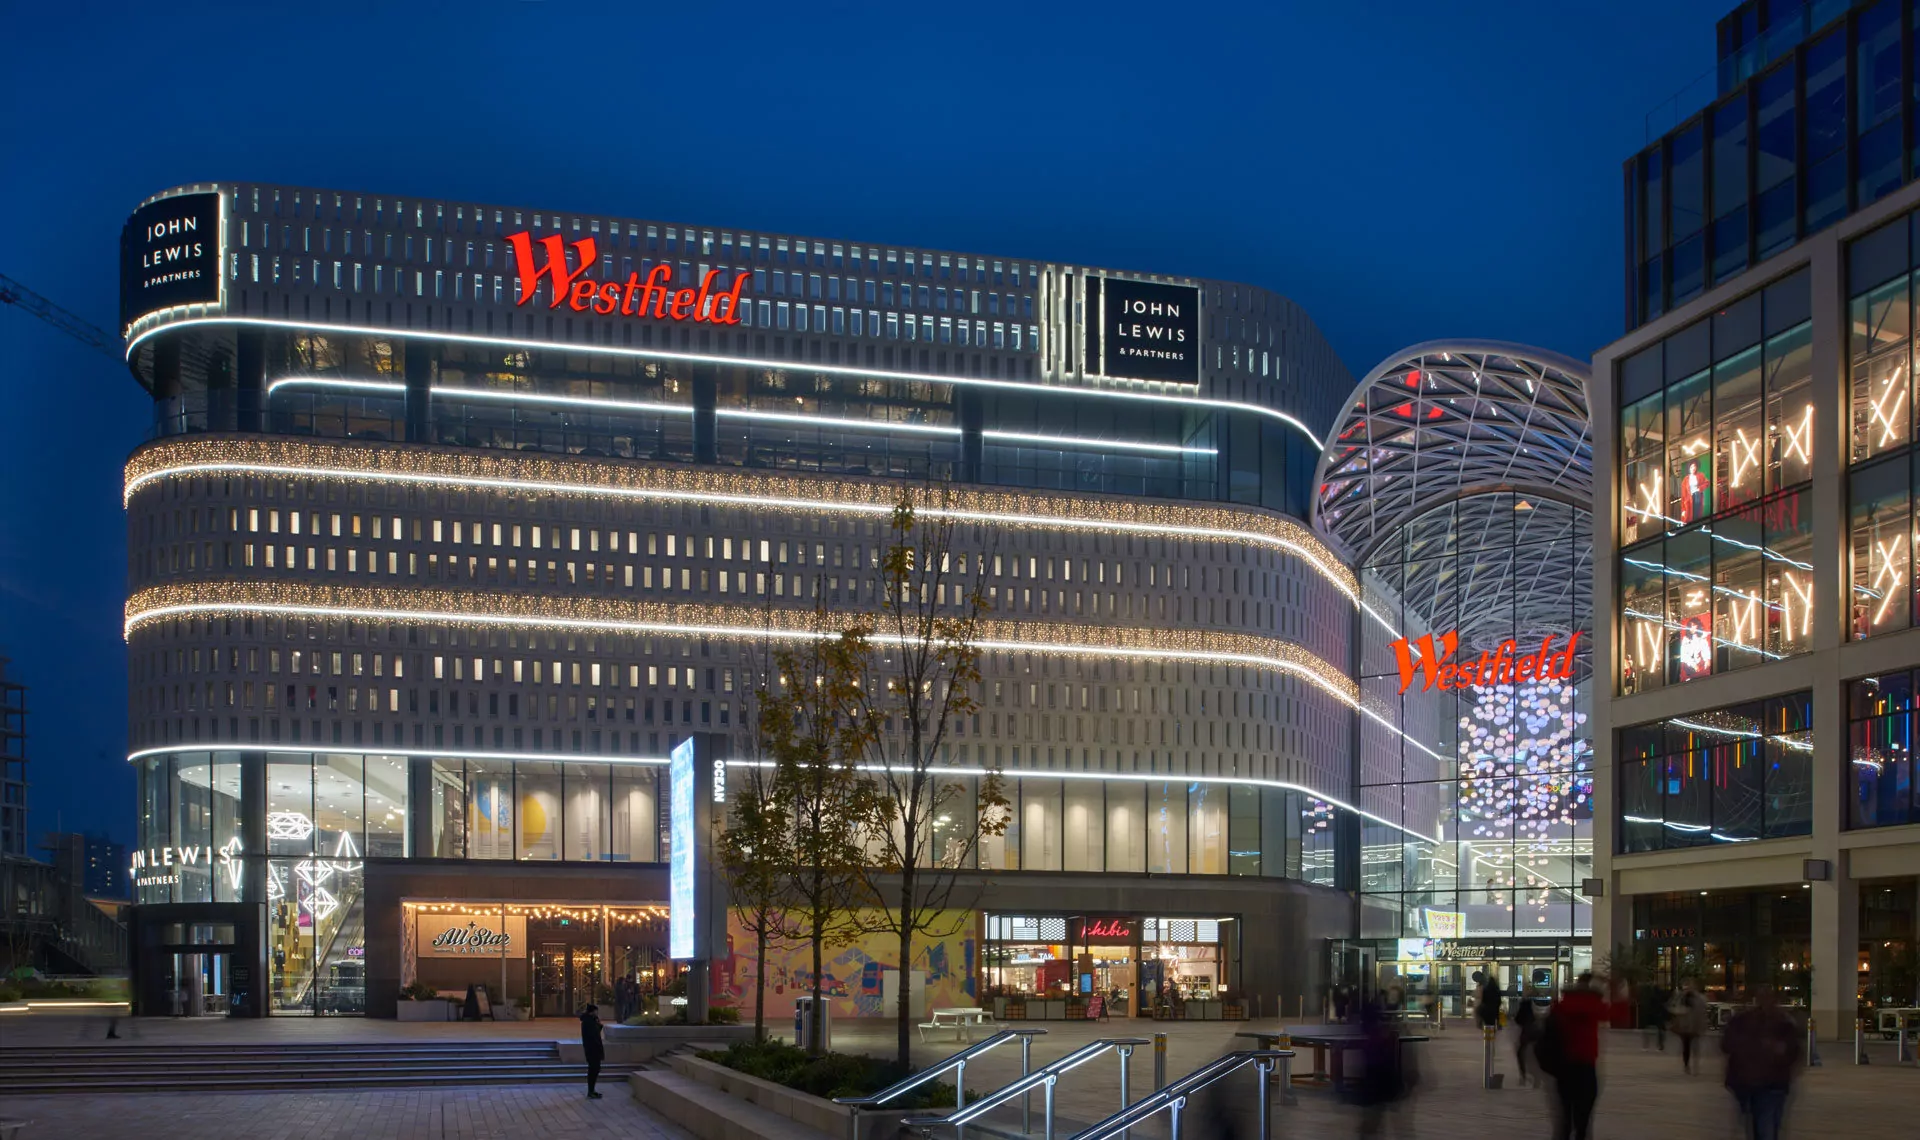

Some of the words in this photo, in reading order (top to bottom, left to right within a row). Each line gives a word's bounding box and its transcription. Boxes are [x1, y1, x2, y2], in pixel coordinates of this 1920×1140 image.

[147, 216, 196, 242] JOHN
[143, 243, 202, 268] LEWIS
[143, 280, 149, 288] &
[151, 269, 201, 286] PARTNERS
[503, 231, 752, 325] Westfield
[1123, 299, 1180, 318] JOHN
[1118, 323, 1185, 342] LEWIS
[1119, 347, 1126, 355] &
[1129, 348, 1184, 361] PARTNERS
[1386, 629, 1585, 695] Westfield
[713, 759, 725, 802] OCEAN
[151, 846, 231, 866] LEWIS
[141, 875, 179, 886] PARTNERS
[432, 927, 469, 946] All
[468, 927, 511, 947] Star
[1439, 941, 1486, 957] Westfield
